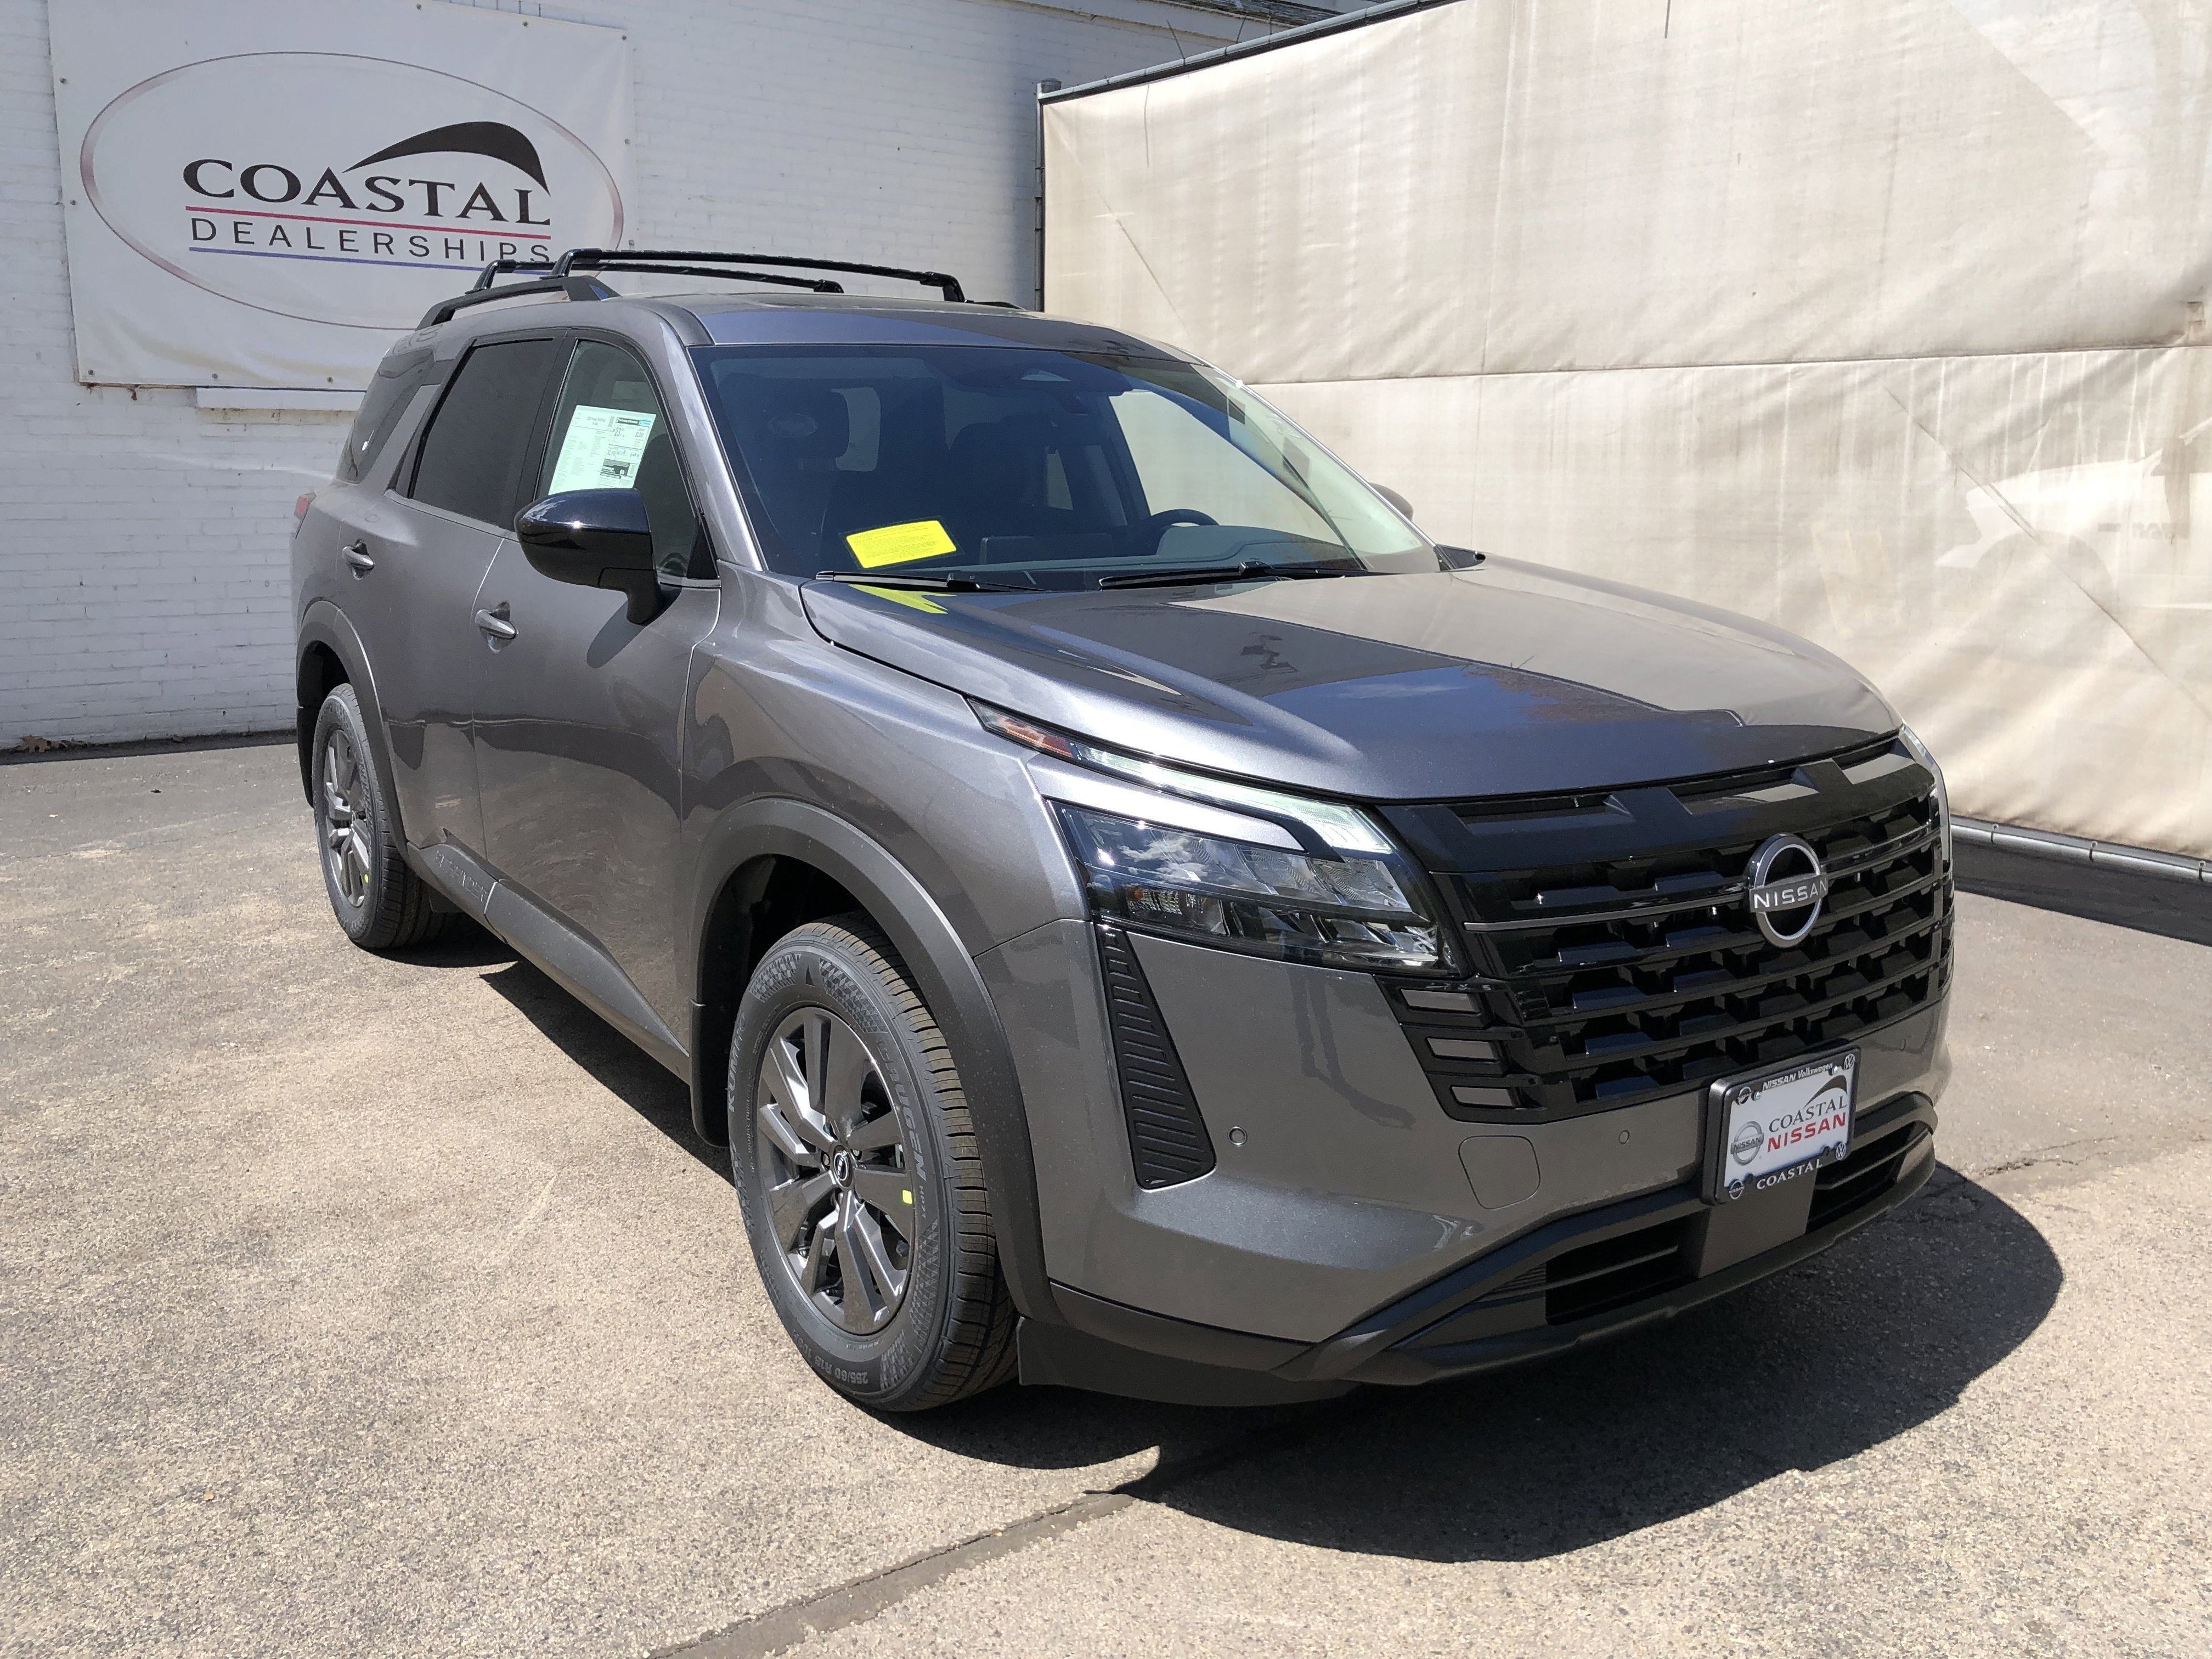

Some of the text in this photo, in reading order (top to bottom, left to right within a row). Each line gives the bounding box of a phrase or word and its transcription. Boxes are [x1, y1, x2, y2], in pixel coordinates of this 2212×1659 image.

[183, 159, 550, 225] COASTAL
[191, 218, 549, 262] DEALERSHIPS
[1754, 878, 1827, 909] NISSAN
[729, 1012, 746, 1112] KUMHO
[1762, 1063, 1833, 1090] NISSAN Volkswagen
[1769, 1096, 1847, 1132] COASTAL
[1734, 1136, 1762, 1151] NISSAN
[1768, 1113, 1846, 1152] NISSAN
[1757, 1159, 1822, 1189] COASTAL
